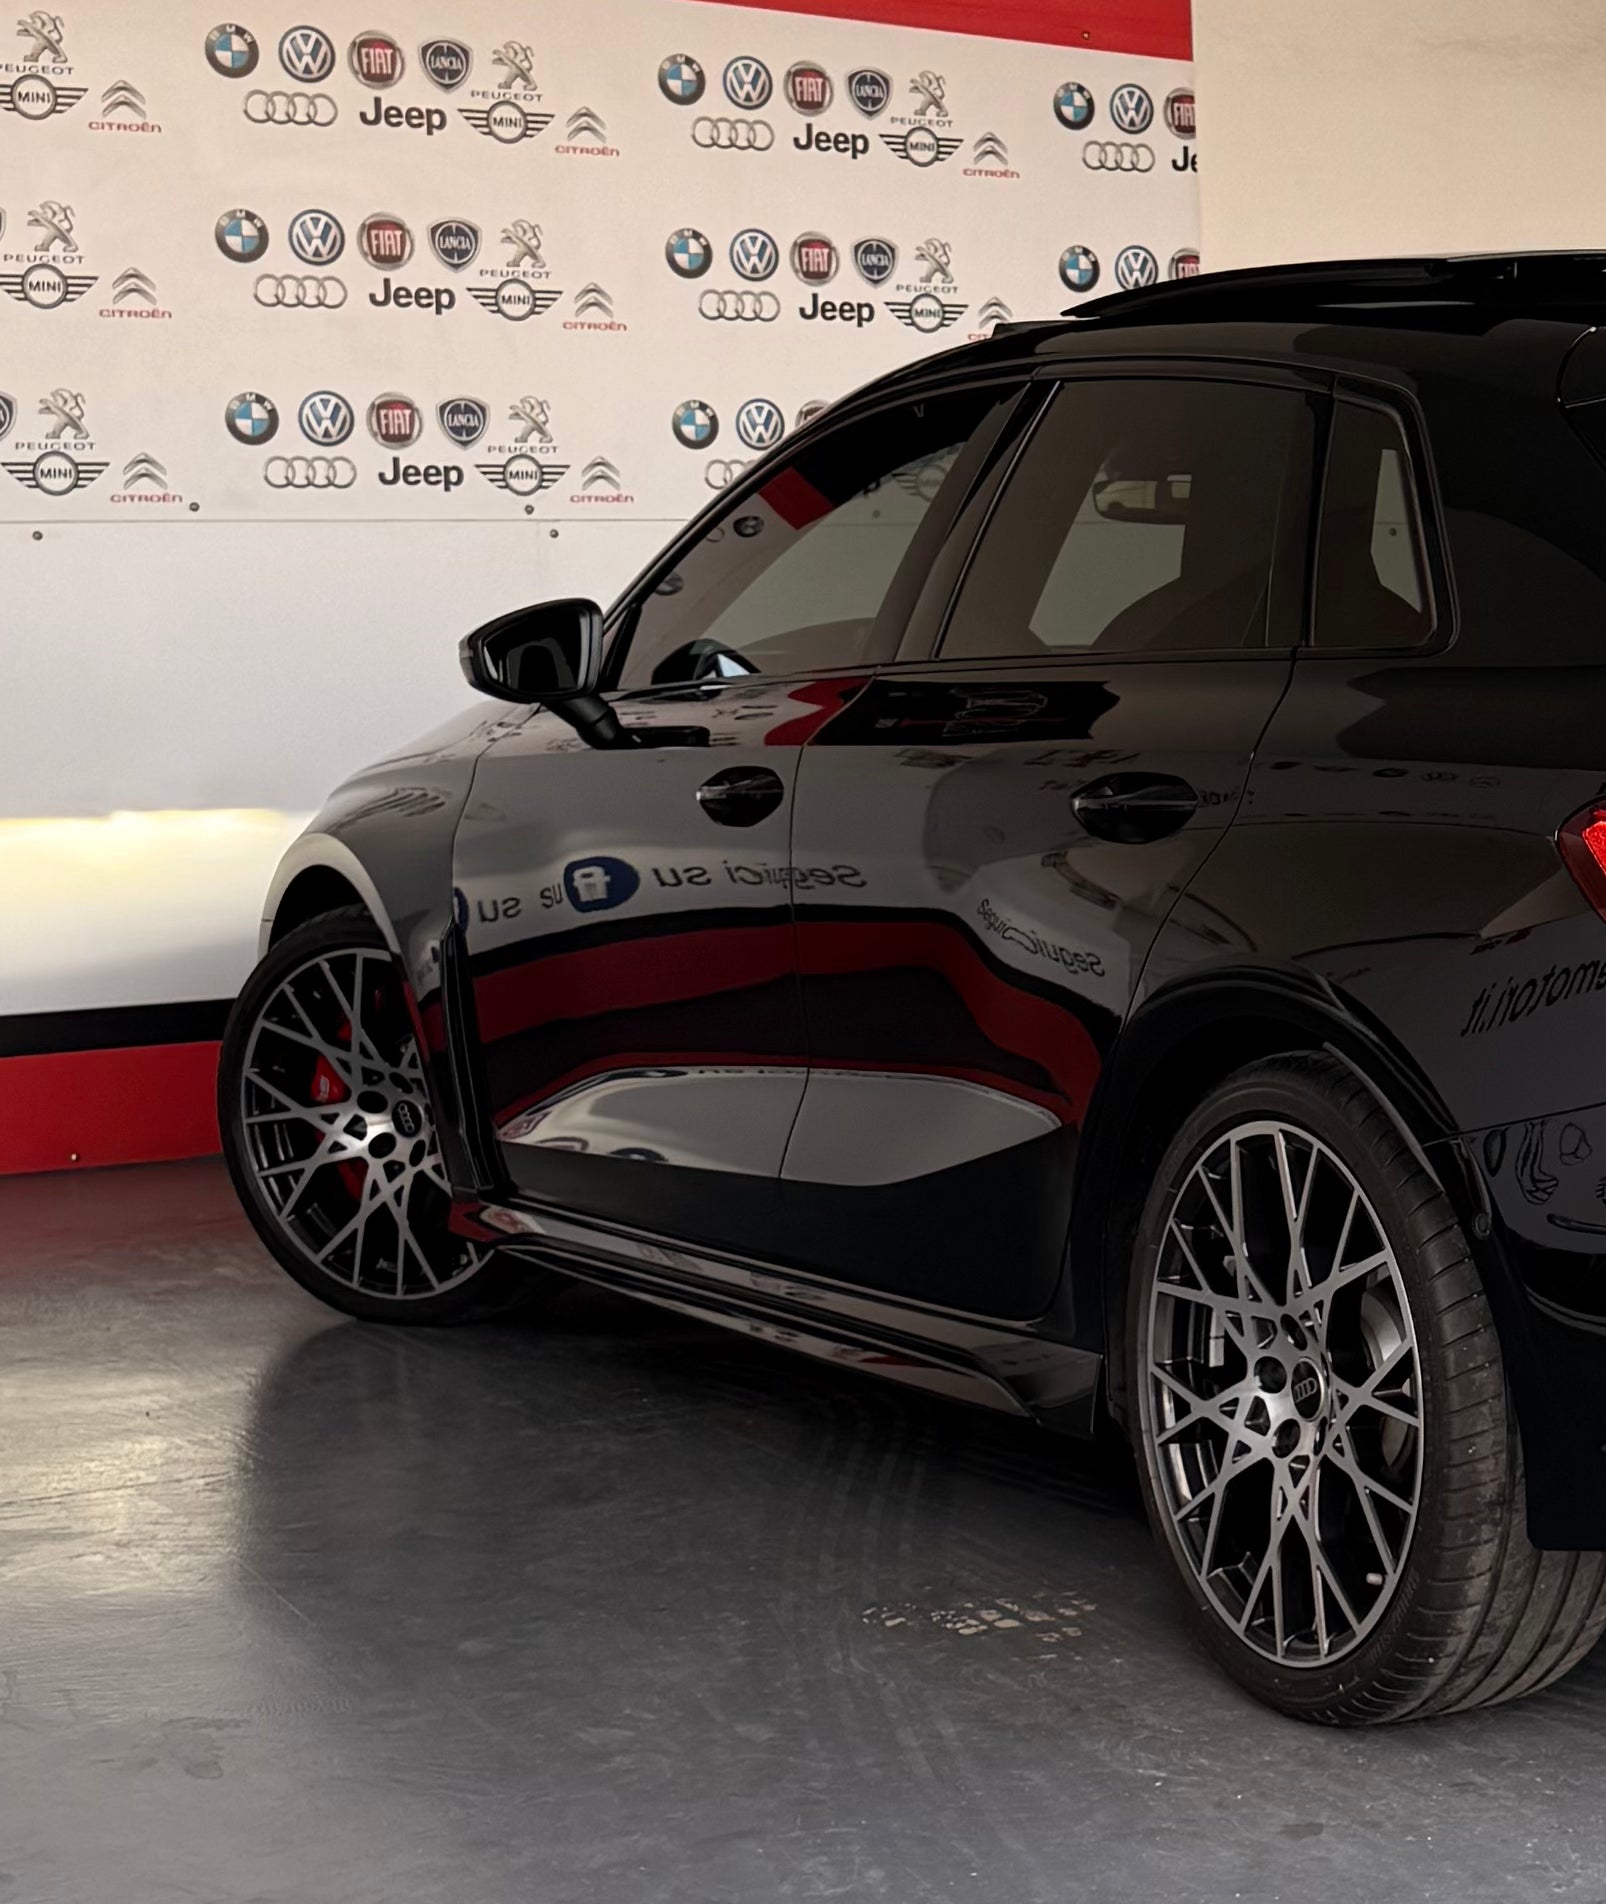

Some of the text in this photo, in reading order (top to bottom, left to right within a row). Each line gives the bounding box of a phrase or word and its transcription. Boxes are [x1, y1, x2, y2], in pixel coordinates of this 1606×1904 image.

[360, 46, 394, 75] FIAT
[18, 90, 50, 104] MINI
[795, 76, 824, 103] FIAT
[359, 96, 447, 135] Jeep
[492, 116, 523, 129] MINI
[793, 122, 869, 160] Jeep
[369, 229, 403, 256] FIAT
[801, 247, 830, 273] FIAT
[28, 280, 62, 293] MINI
[368, 277, 456, 316] Jeep
[500, 294, 531, 306] MINI
[799, 292, 876, 328] Jeep
[379, 408, 412, 436] FIAT
[40, 468, 72, 480] MINI
[378, 456, 464, 492] Jeep
[508, 469, 538, 481] MINI
